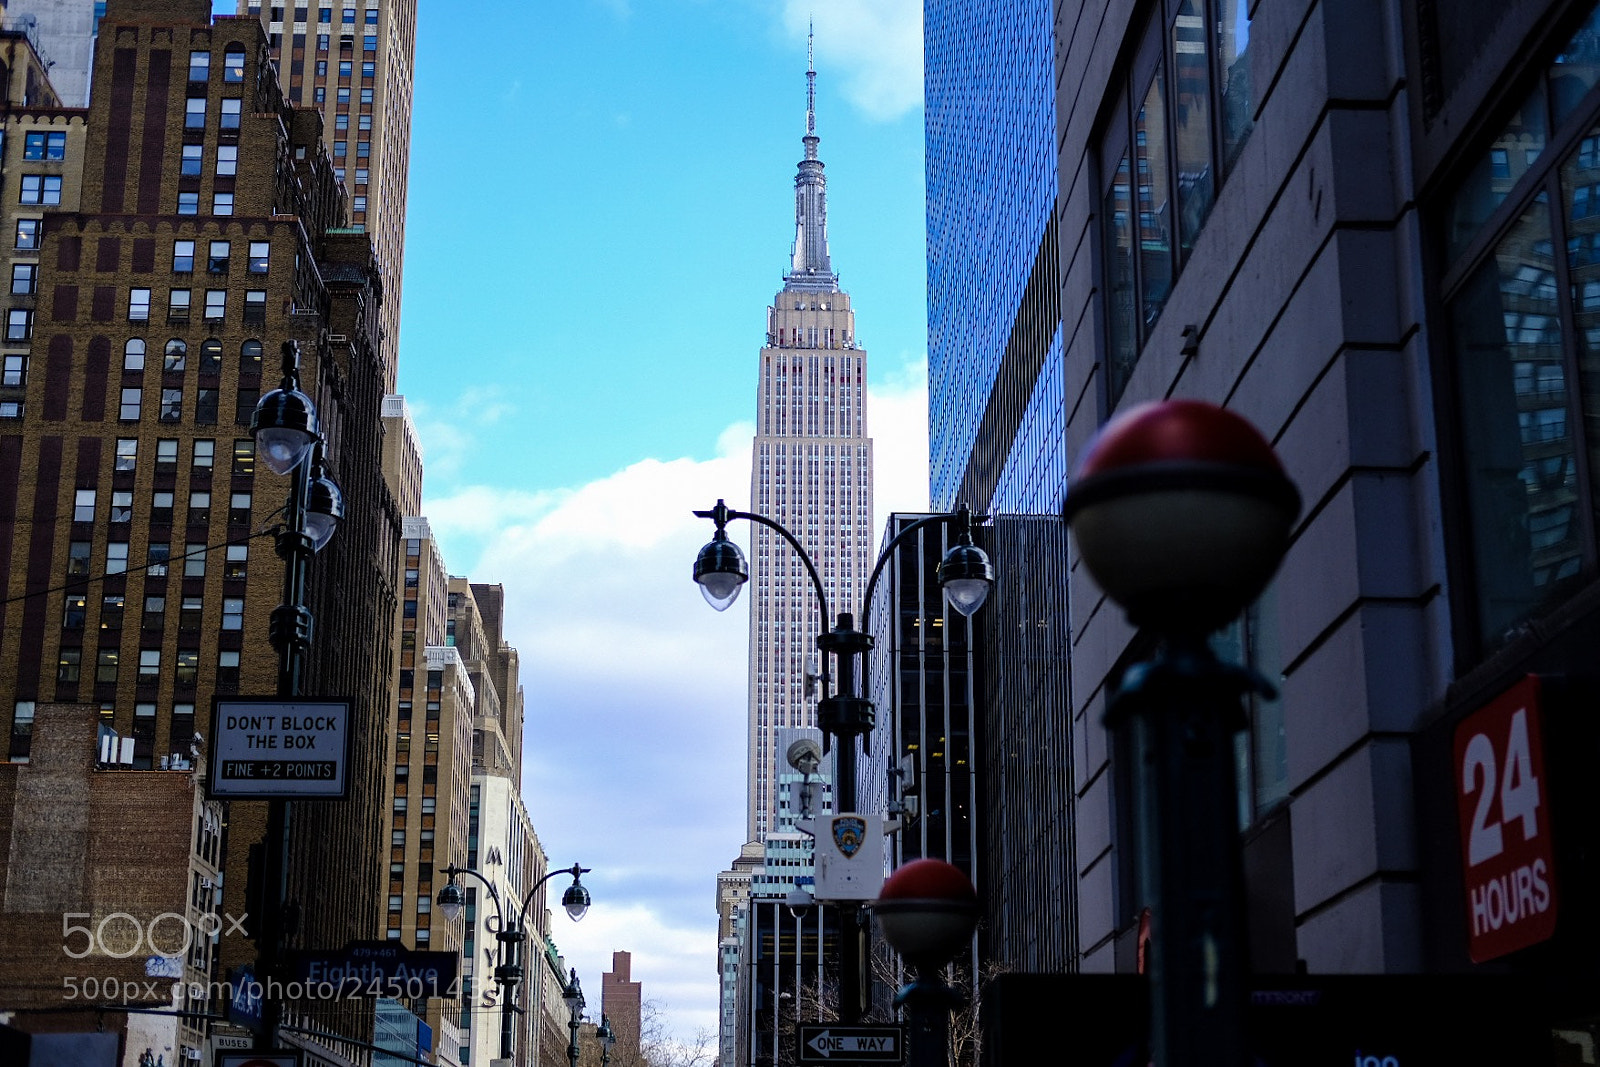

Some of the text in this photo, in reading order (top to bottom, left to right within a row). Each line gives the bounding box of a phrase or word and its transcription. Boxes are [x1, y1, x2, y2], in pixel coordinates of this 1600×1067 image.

[227, 716, 337, 731] DON'T BLOCK
[246, 735, 316, 749] THE BOX
[226, 762, 332, 778] FINE +2 POINTS
[1463, 707, 1540, 867] 24
[1471, 858, 1550, 937] HOURS
[309, 961, 439, 990] Eighth Ave
[219, 1039, 248, 1048] BUSES
[817, 1036, 887, 1050] ONE WAY
